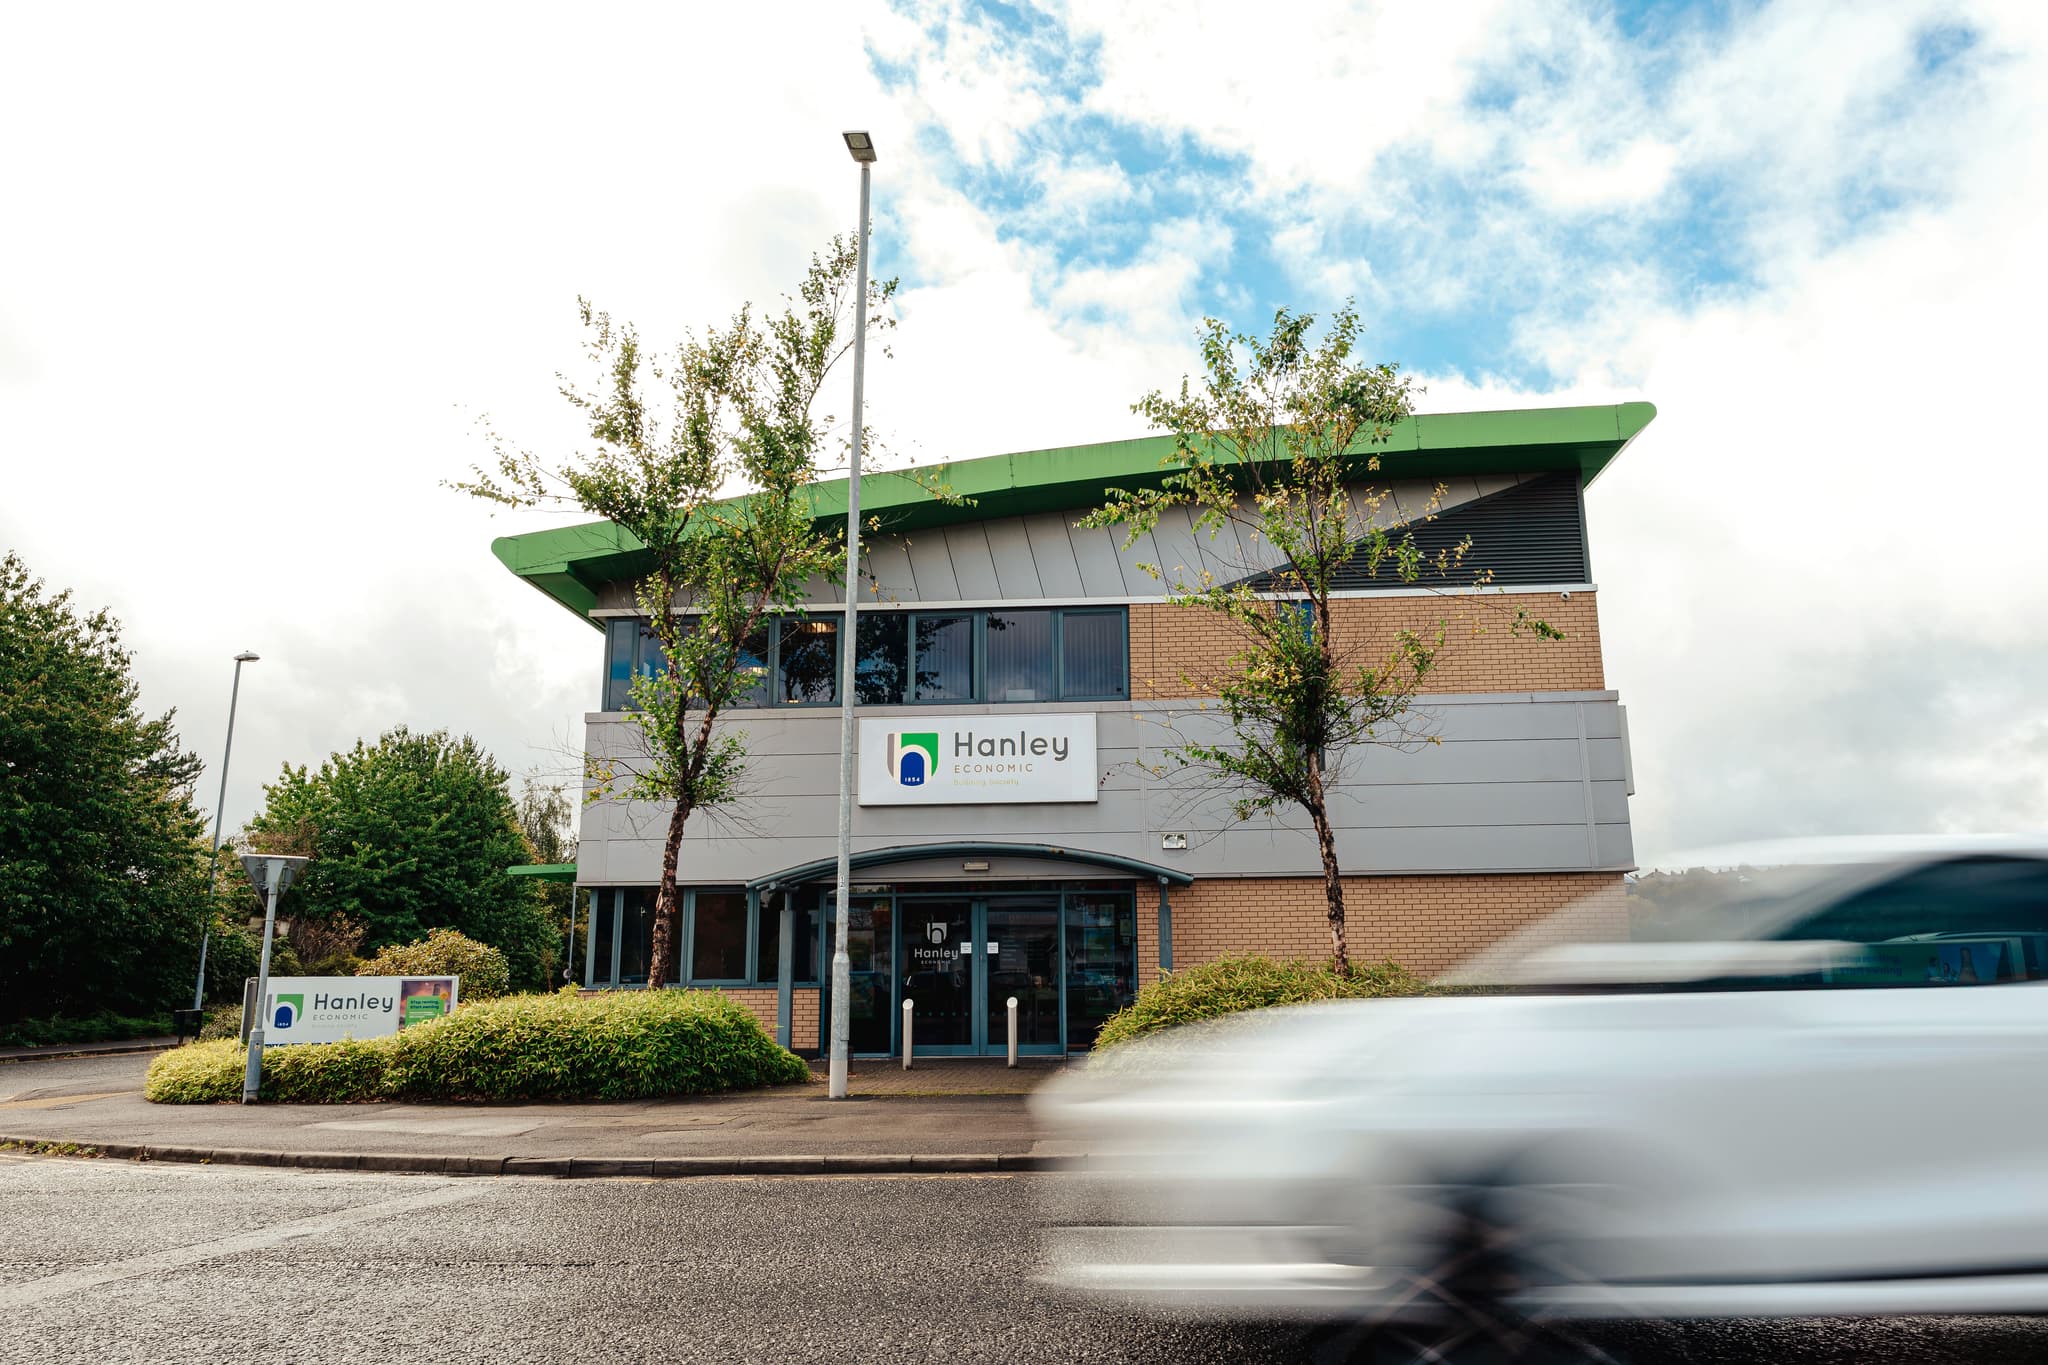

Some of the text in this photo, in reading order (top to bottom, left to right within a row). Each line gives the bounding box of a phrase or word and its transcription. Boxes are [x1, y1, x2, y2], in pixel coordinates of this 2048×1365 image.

[954, 731, 1068, 761] Hanley
[954, 763, 1033, 774] ECONOMIC
[914, 947, 959, 960] Hanley
[314, 993, 393, 1013] Hanley
